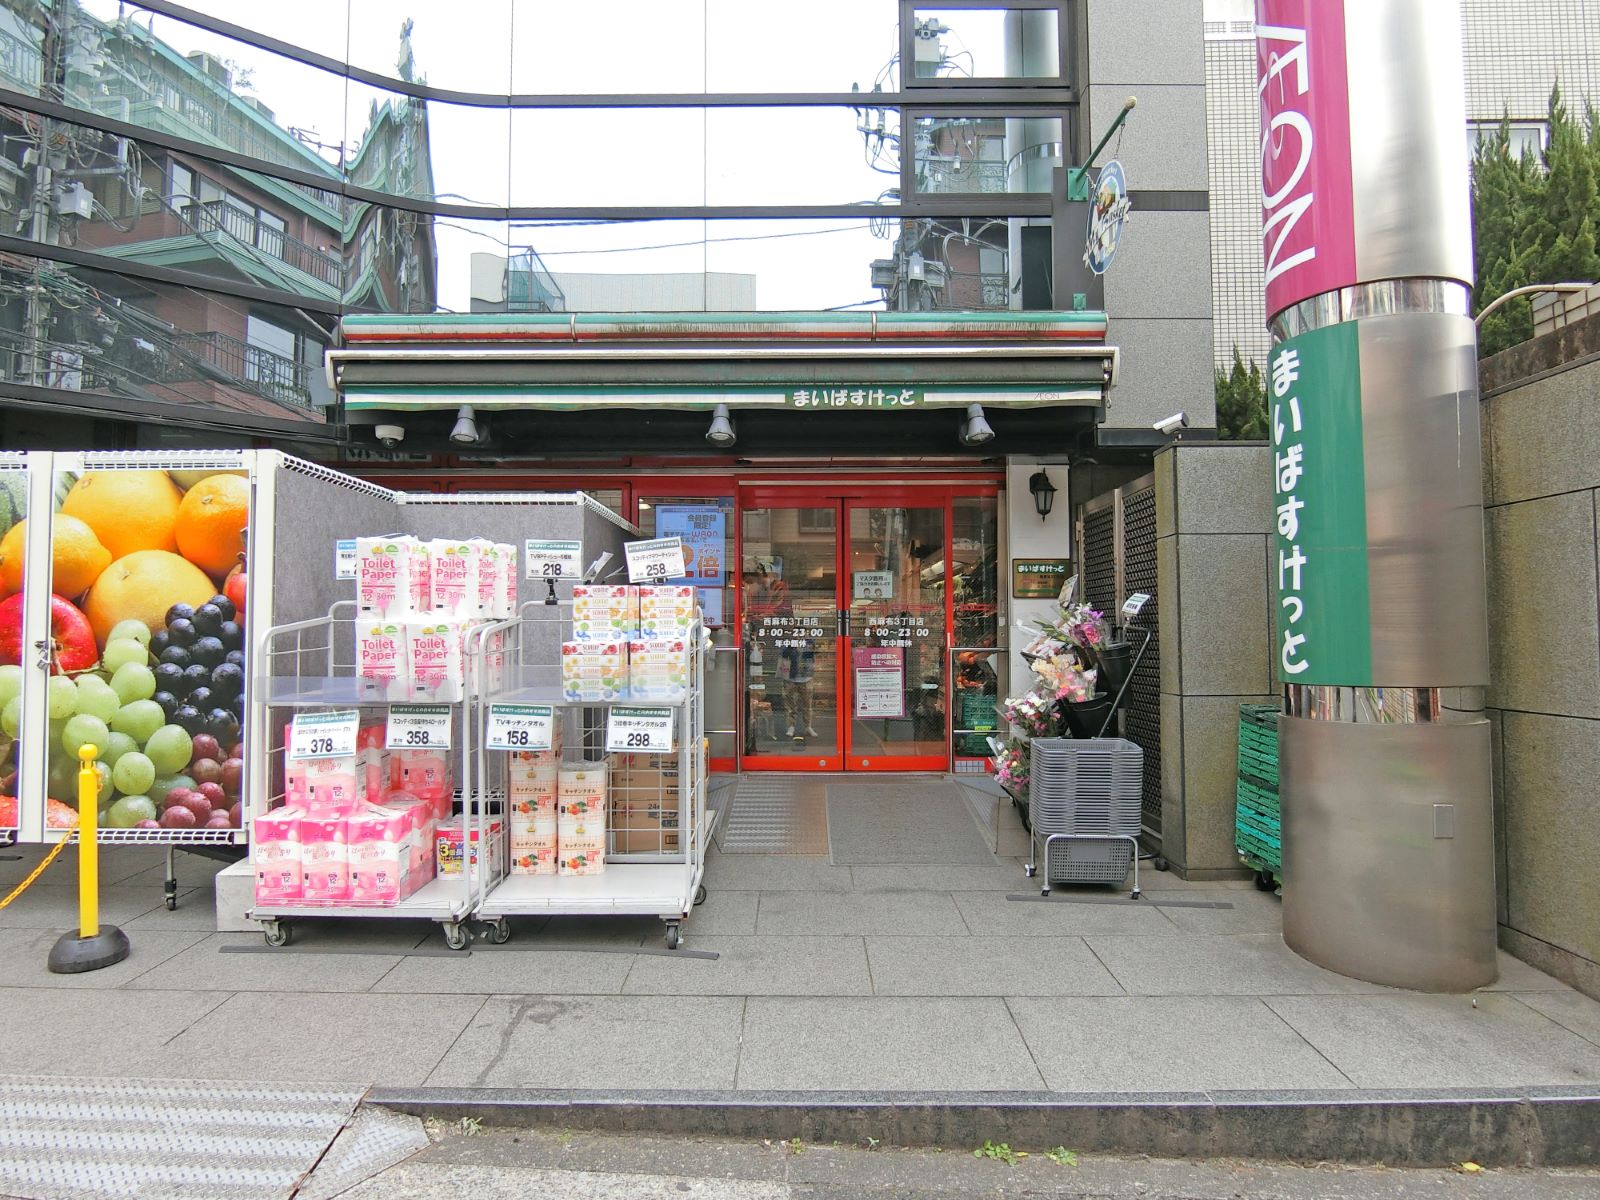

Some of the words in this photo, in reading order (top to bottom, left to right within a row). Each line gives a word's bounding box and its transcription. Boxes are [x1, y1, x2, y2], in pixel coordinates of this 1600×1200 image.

[793, 389, 916, 406] まいばすけっと
[1272, 349, 1309, 675] まいばすけっと
[362, 558, 395, 568] Toilet
[436, 558, 466, 568] Toilet
[362, 569, 397, 580] Paper
[437, 569, 468, 579] Paper
[543, 563, 561, 575] 218
[646, 563, 666, 576] 258
[1018, 565, 1065, 573] まいばすけっと
[763, 618, 818, 626] 西麻布3丁目店
[869, 618, 924, 626] 西麻布3丁目店
[362, 640, 394, 649] Toilet
[413, 639, 445, 648] Toilet
[774, 639, 807, 648] 年中無休
[880, 639, 913, 648] 年中無休
[363, 650, 396, 661] Paper
[415, 649, 448, 661] Paper
[406, 731, 430, 744] 358
[507, 730, 529, 745] 158
[627, 733, 650, 747] 298
[311, 738, 333, 753] 378
